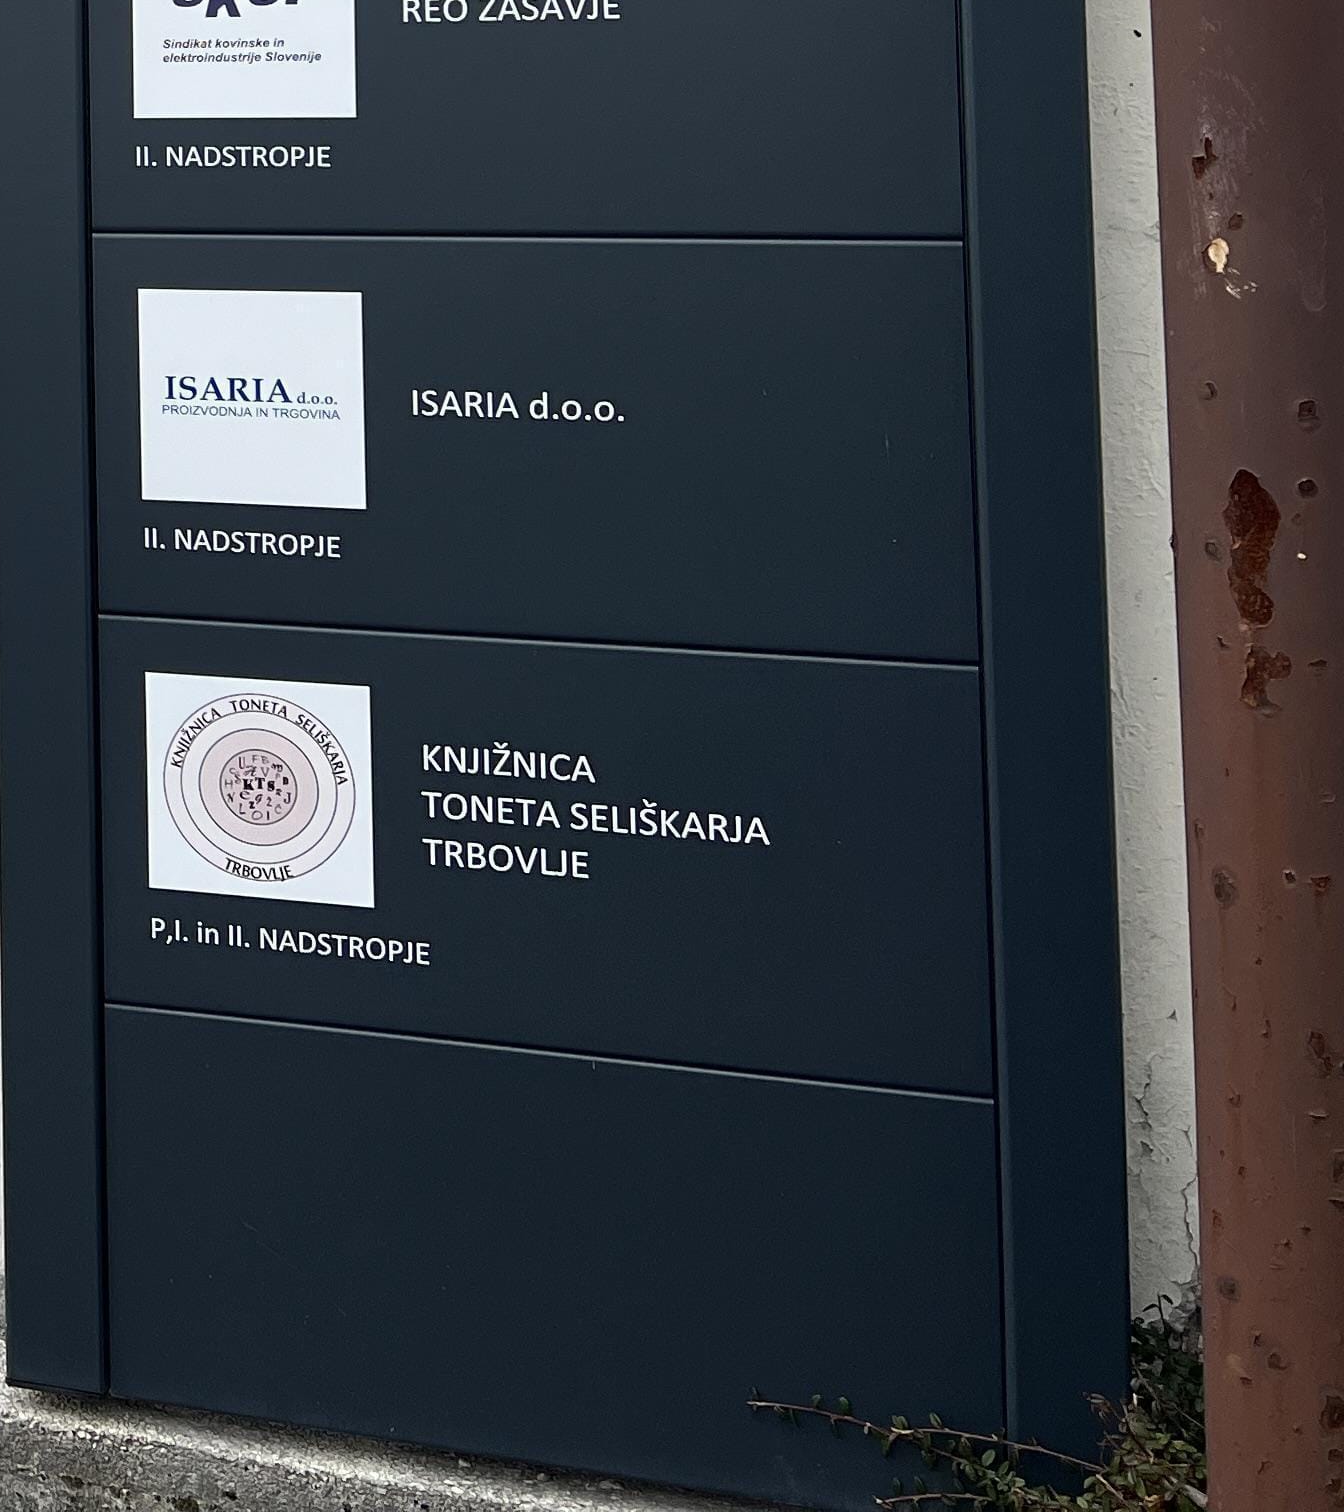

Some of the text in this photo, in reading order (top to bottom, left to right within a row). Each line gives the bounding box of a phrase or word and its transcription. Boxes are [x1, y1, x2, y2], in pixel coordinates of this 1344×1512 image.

[162, 51, 322, 65] elektroindustrije Slovenije
[163, 37, 285, 49] Sindikat kovinske in
[135, 145, 332, 168] II. NADSTROPJE
[164, 375, 339, 405] ISARIA d.o.o.
[411, 389, 625, 422] ISARIA d.o.o.
[162, 404, 341, 420] PROIZVODNJA IN TRGOVINA
[144, 527, 341, 559] II. NADSTROPJE
[170, 699, 348, 785] KNJIŽNICA TONETA SELIŠKARJA
[422, 741, 596, 784] KNJIŽNICA
[420, 790, 771, 846] TONETA SELIŠKARJA
[224, 857, 295, 882] TRBOVLJE
[421, 837, 590, 879] TRBOVLJE
[197, 921, 220, 945] in
[228, 924, 251, 948] II.
[259, 927, 431, 966] NADSTROPJE
